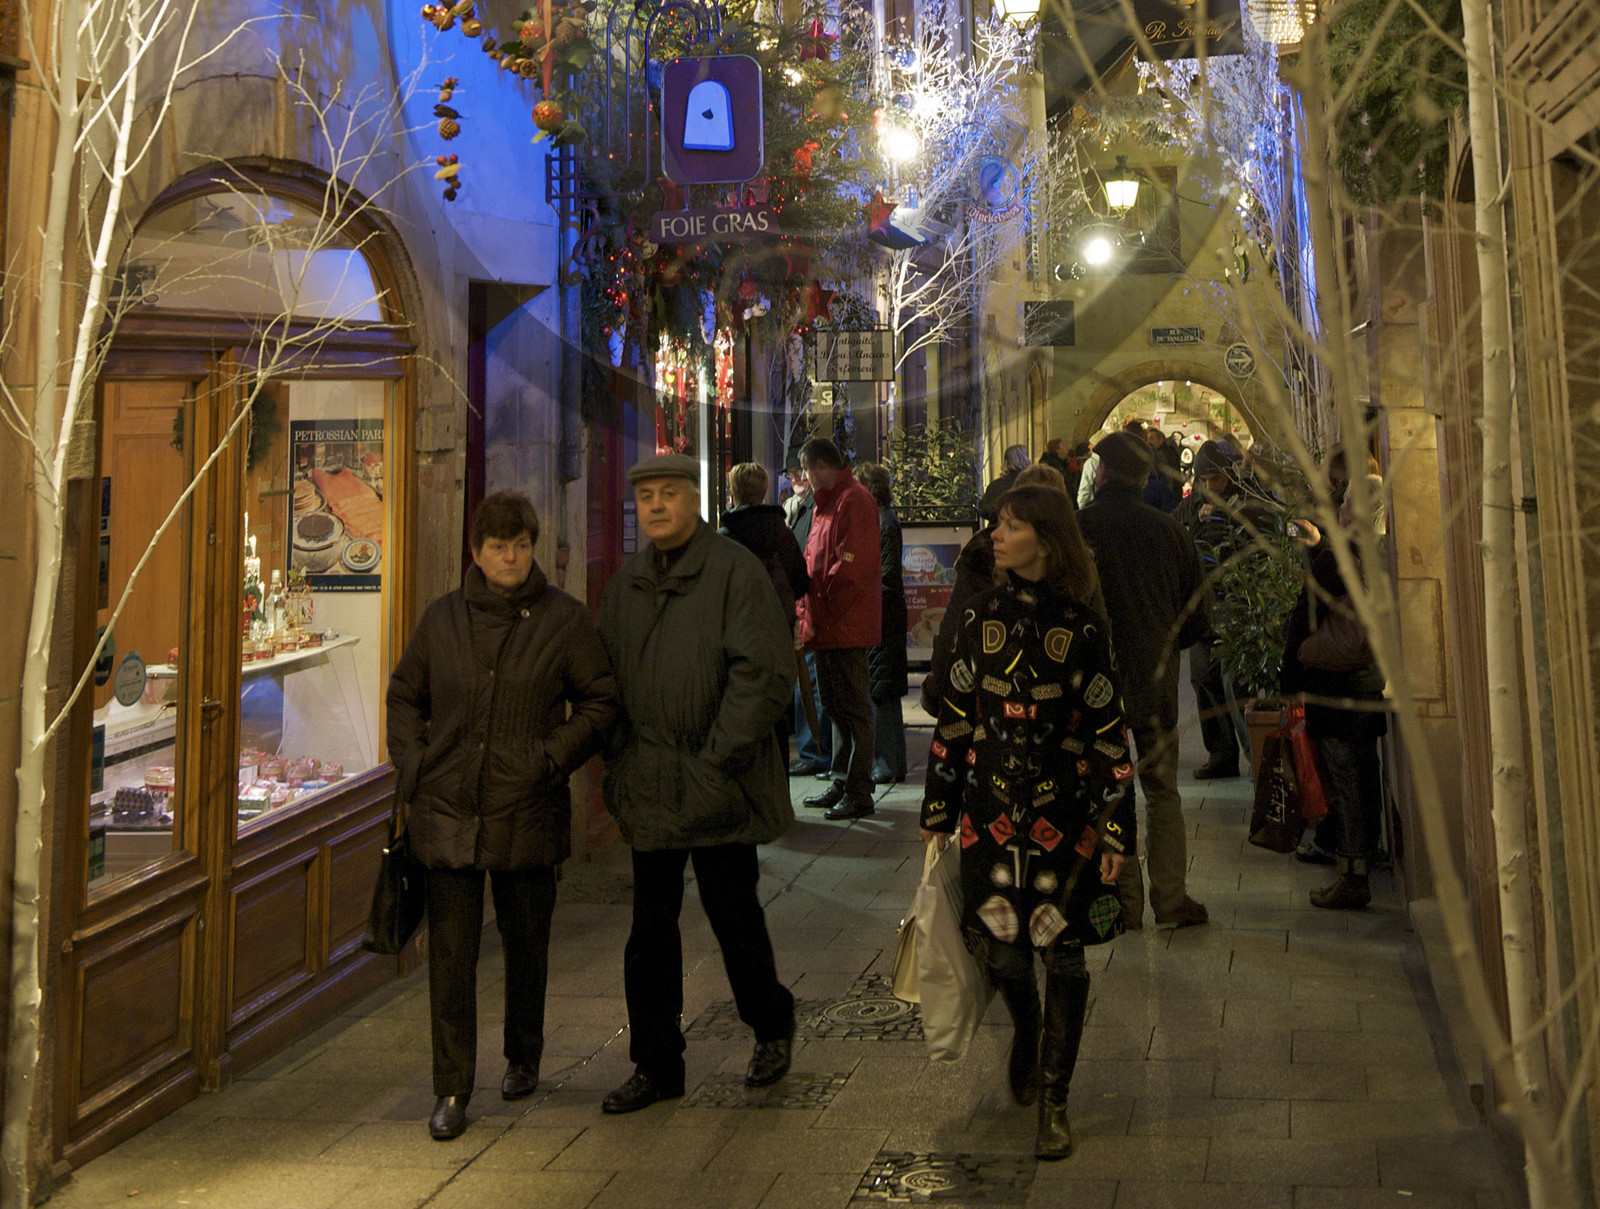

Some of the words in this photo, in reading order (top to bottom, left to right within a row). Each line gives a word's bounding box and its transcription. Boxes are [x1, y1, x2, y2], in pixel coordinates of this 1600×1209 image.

[660, 215, 706, 238] FOIE
[712, 210, 769, 233] GRAS
[295, 429, 359, 442] PETROSSIAN
[362, 429, 384, 441] PARI
